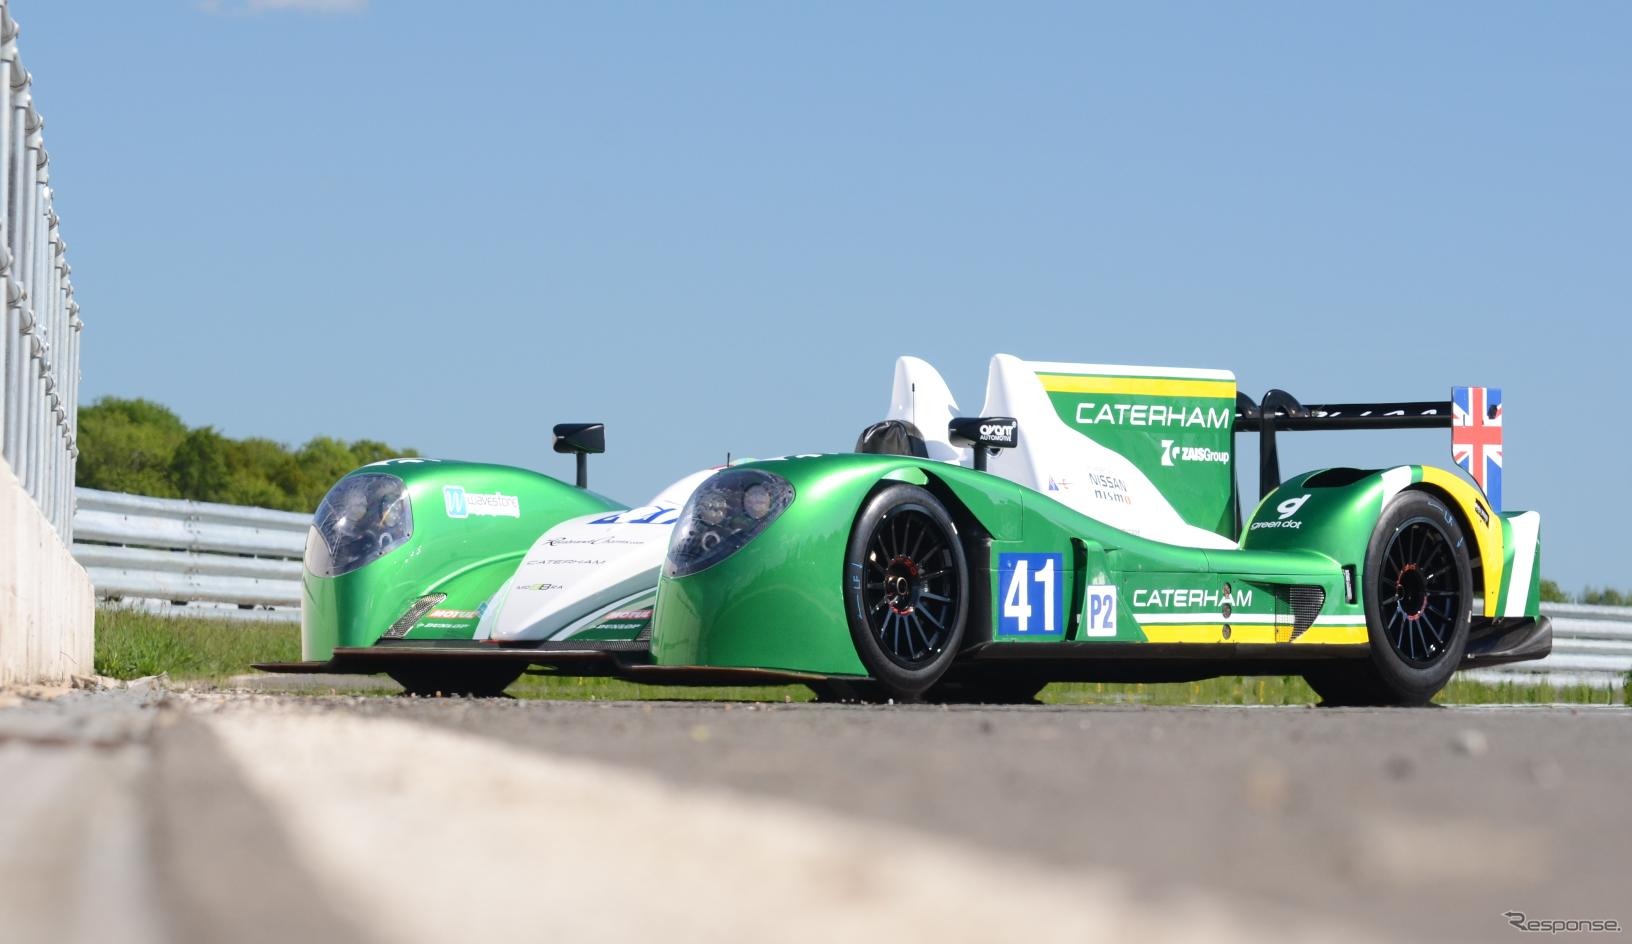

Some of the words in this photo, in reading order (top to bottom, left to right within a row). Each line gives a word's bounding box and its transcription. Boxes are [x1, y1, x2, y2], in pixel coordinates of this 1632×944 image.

[1075, 402, 1230, 429] CATERHAM
[1089, 473, 1128, 492] NISSAN
[1094, 489, 1132, 504] nismo
[1250, 521, 1282, 531] green
[1281, 519, 1303, 530] dot
[1004, 558, 1055, 632] 41
[1132, 589, 1253, 608] CATERHAM
[1090, 594, 1114, 629] P2
